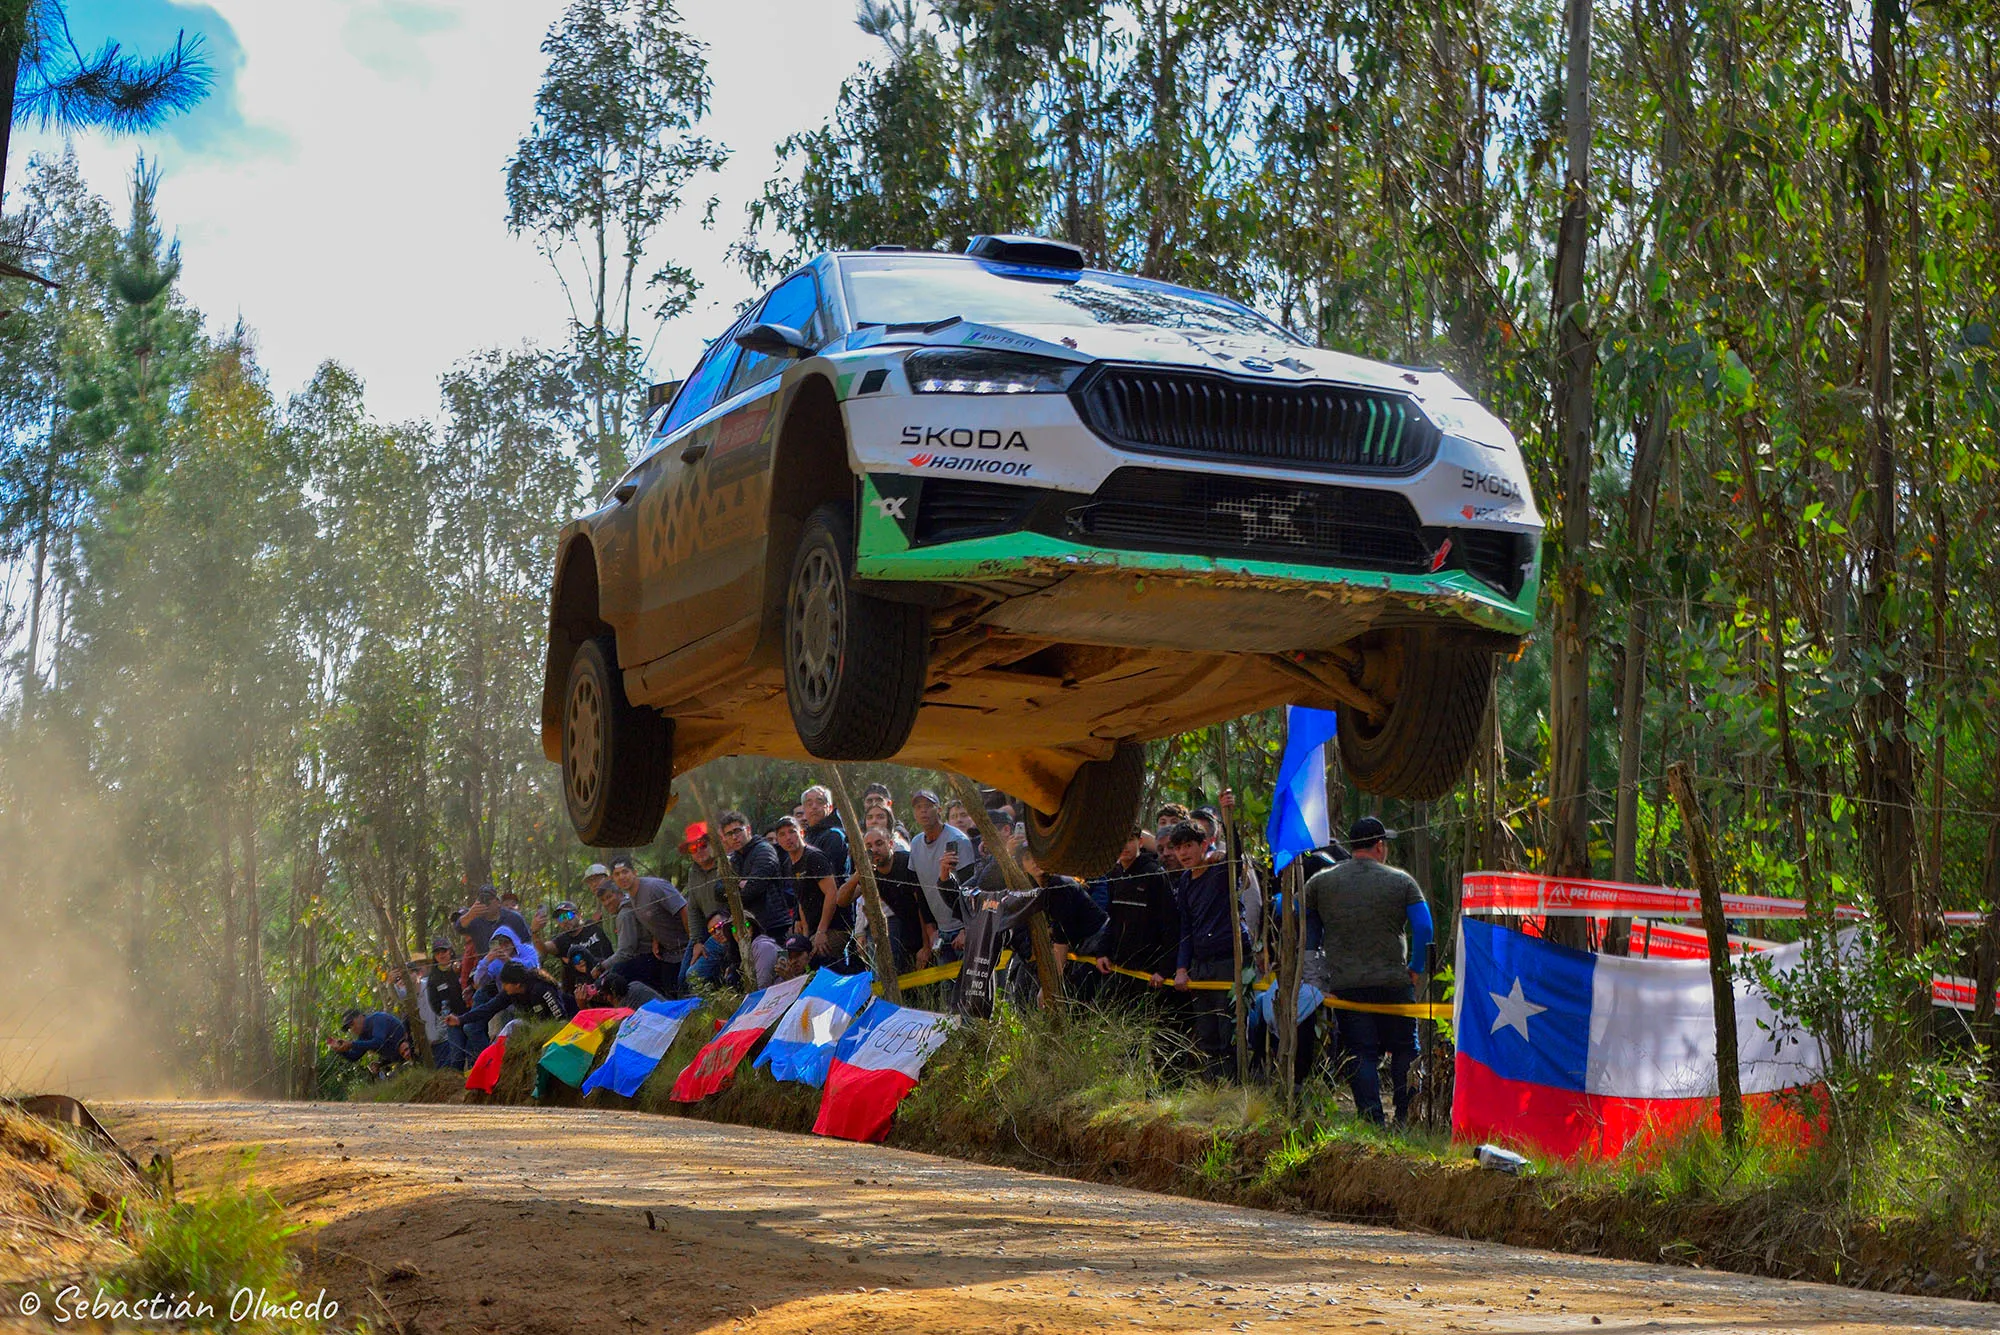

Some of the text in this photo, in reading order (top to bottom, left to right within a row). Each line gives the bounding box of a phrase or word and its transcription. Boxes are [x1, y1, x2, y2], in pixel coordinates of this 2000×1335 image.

[900, 425, 1030, 451] SKODA
[1461, 469, 1525, 502] SKODA
[1569, 887, 1618, 903] PELIGRO
